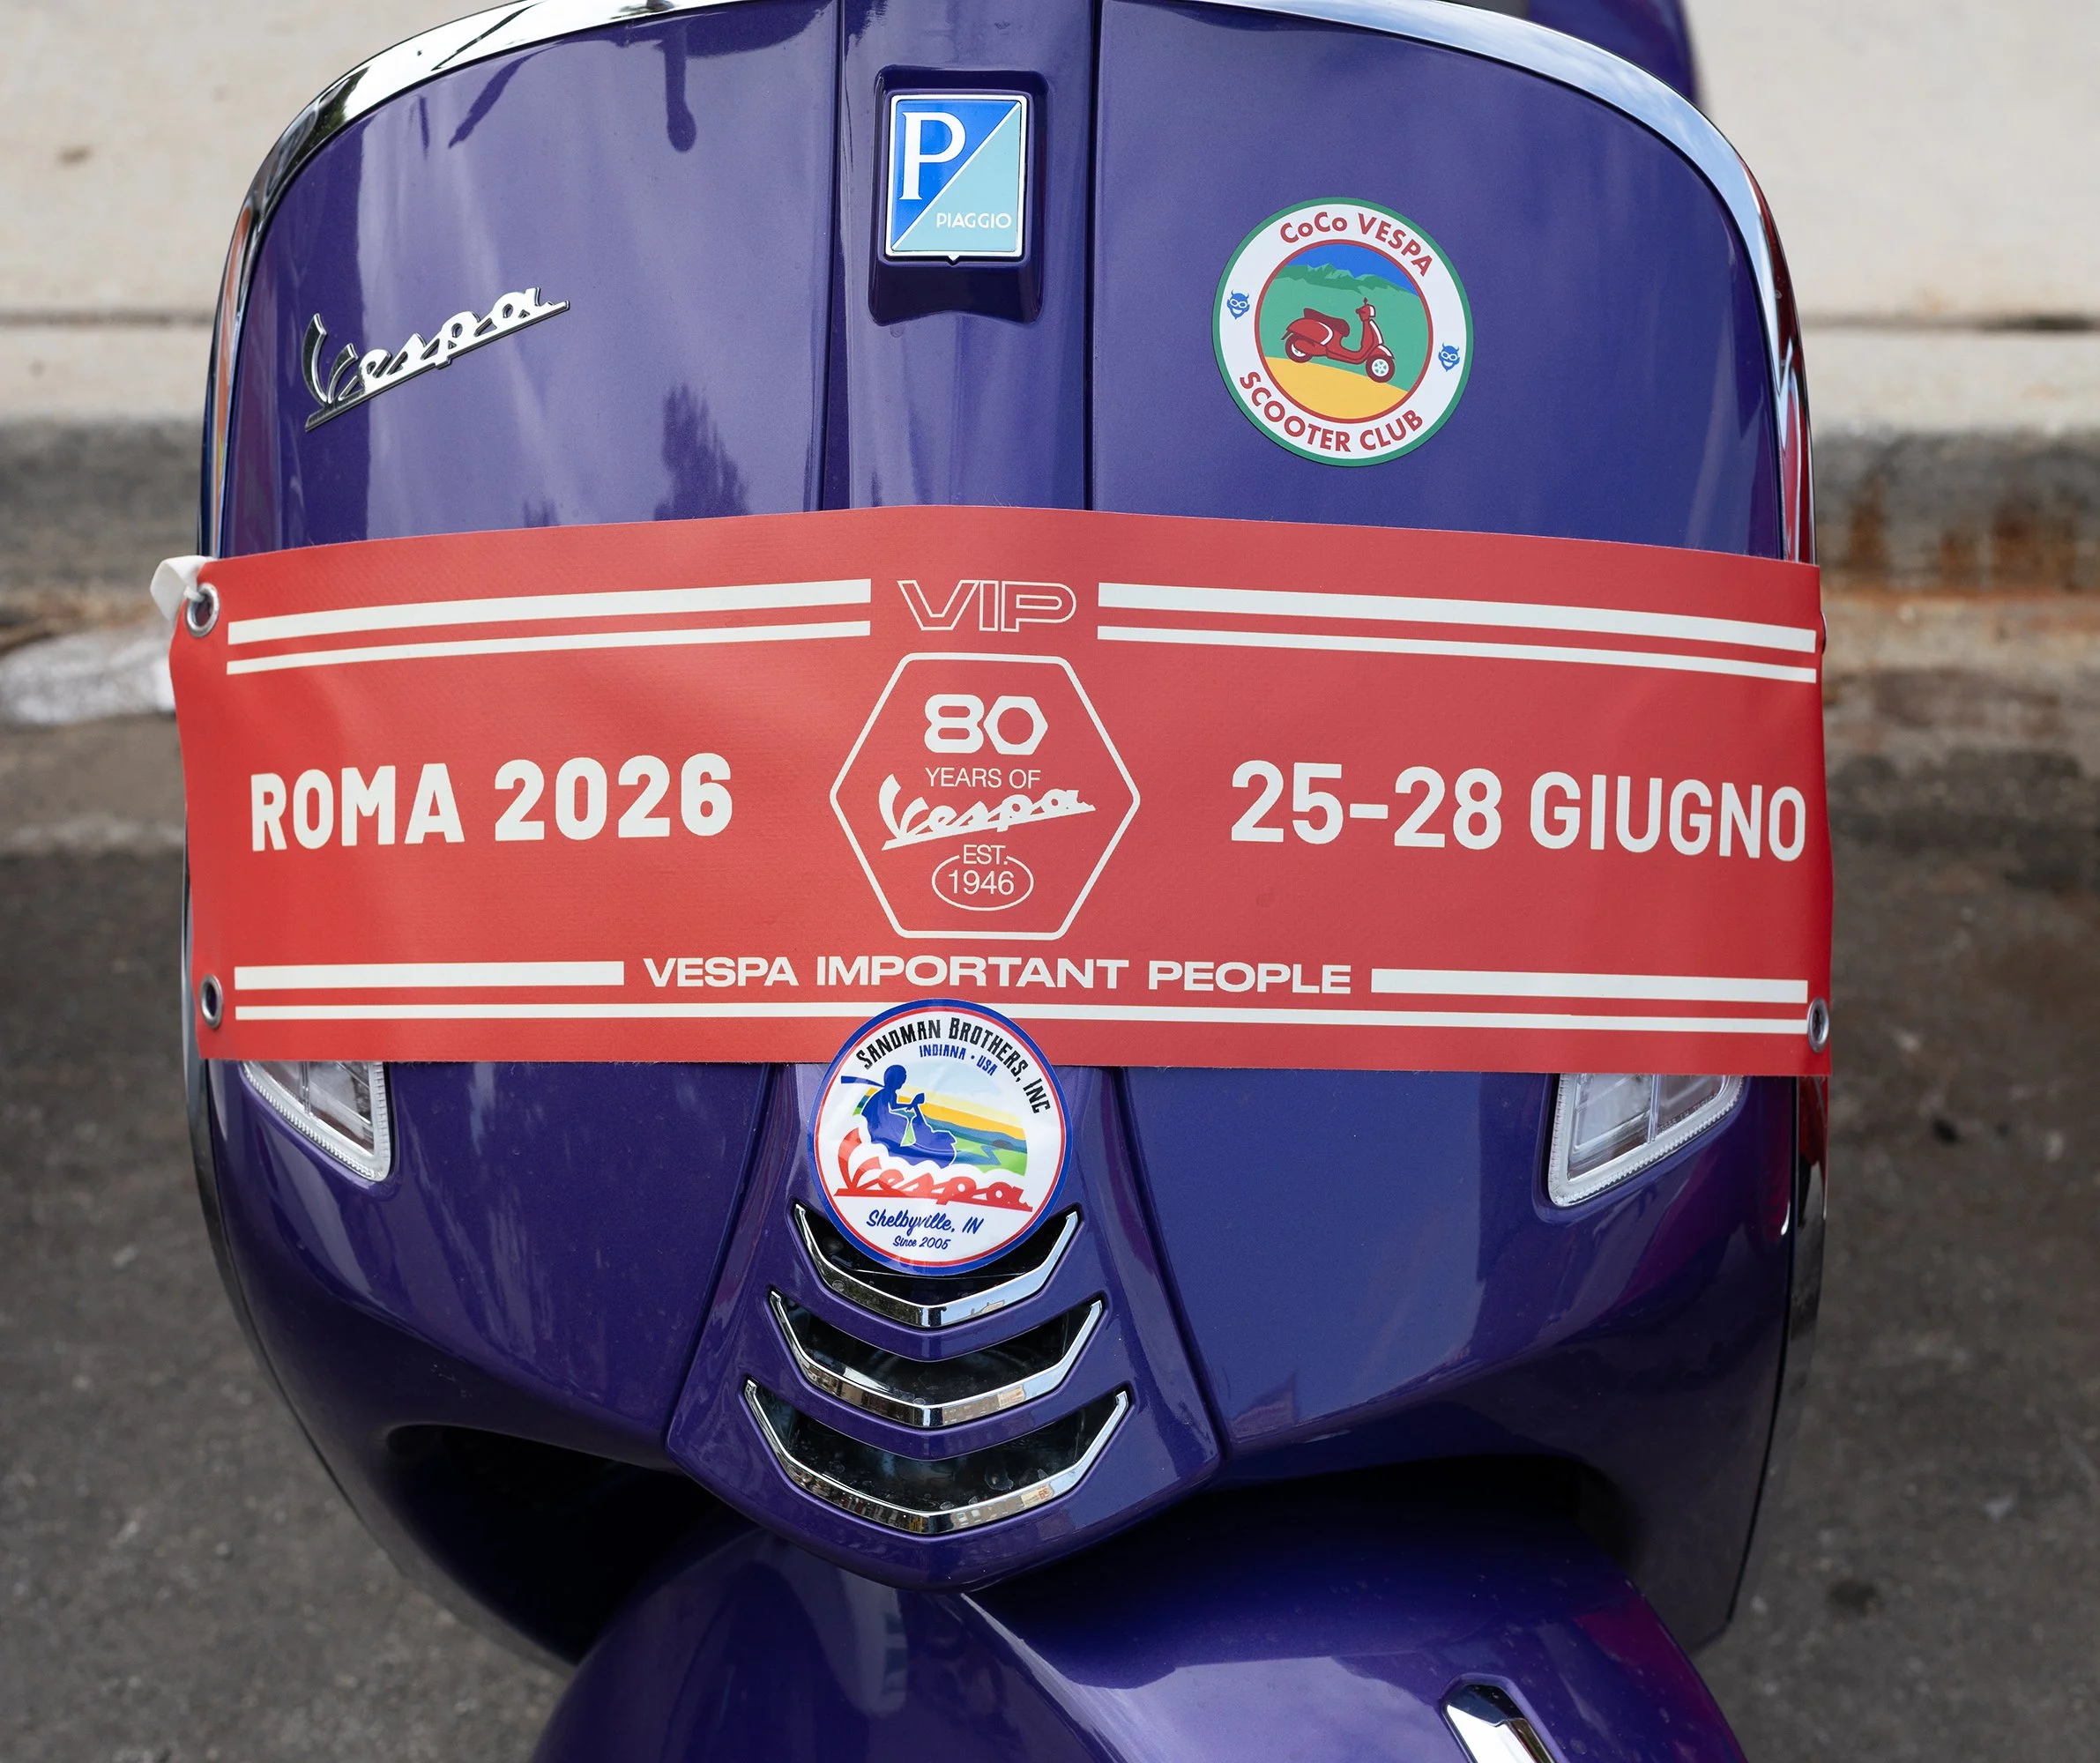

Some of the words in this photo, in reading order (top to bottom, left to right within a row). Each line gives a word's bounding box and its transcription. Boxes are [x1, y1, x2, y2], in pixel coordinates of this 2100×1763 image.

[898, 111, 966, 200] P
[935, 212, 1012, 229] PIAGGIO
[1279, 211, 1348, 244] CoCo
[1358, 212, 1434, 278] VESPA
[301, 286, 570, 433] Vespa
[1240, 371, 1352, 453] SCOOTER
[1359, 409, 1424, 451] CLUB
[897, 578, 1077, 633] VIP
[923, 693, 1049, 755] 80
[250, 762, 465, 852] ROMA
[494, 752, 734, 843] 2026
[924, 767, 1002, 789] YEARS
[1008, 769, 1042, 790] OF
[878, 772, 1097, 852] Vespa
[1231, 759, 1503, 852] 25-28
[1529, 770, 1807, 862] GIUGNO
[948, 868, 1016, 896] 1946
[962, 844, 1009, 867] EST.
[643, 956, 800, 988] VESPA
[816, 955, 1130, 990] IMPORTANT
[1148, 960, 1352, 994] PEOPLE
[855, 1018, 942, 1070] SANDMAN
[1023, 1077, 1052, 1114] INC
[919, 1044, 967, 1060] INDIANA
[976, 1054, 998, 1076] USA
[833, 1127, 1033, 1213] Vespa
[866, 1209, 956, 1237] Shelbyville,
[961, 1216, 985, 1235] IN
[892, 1235, 918, 1247] Since
[919, 1236, 952, 1250] 2005
